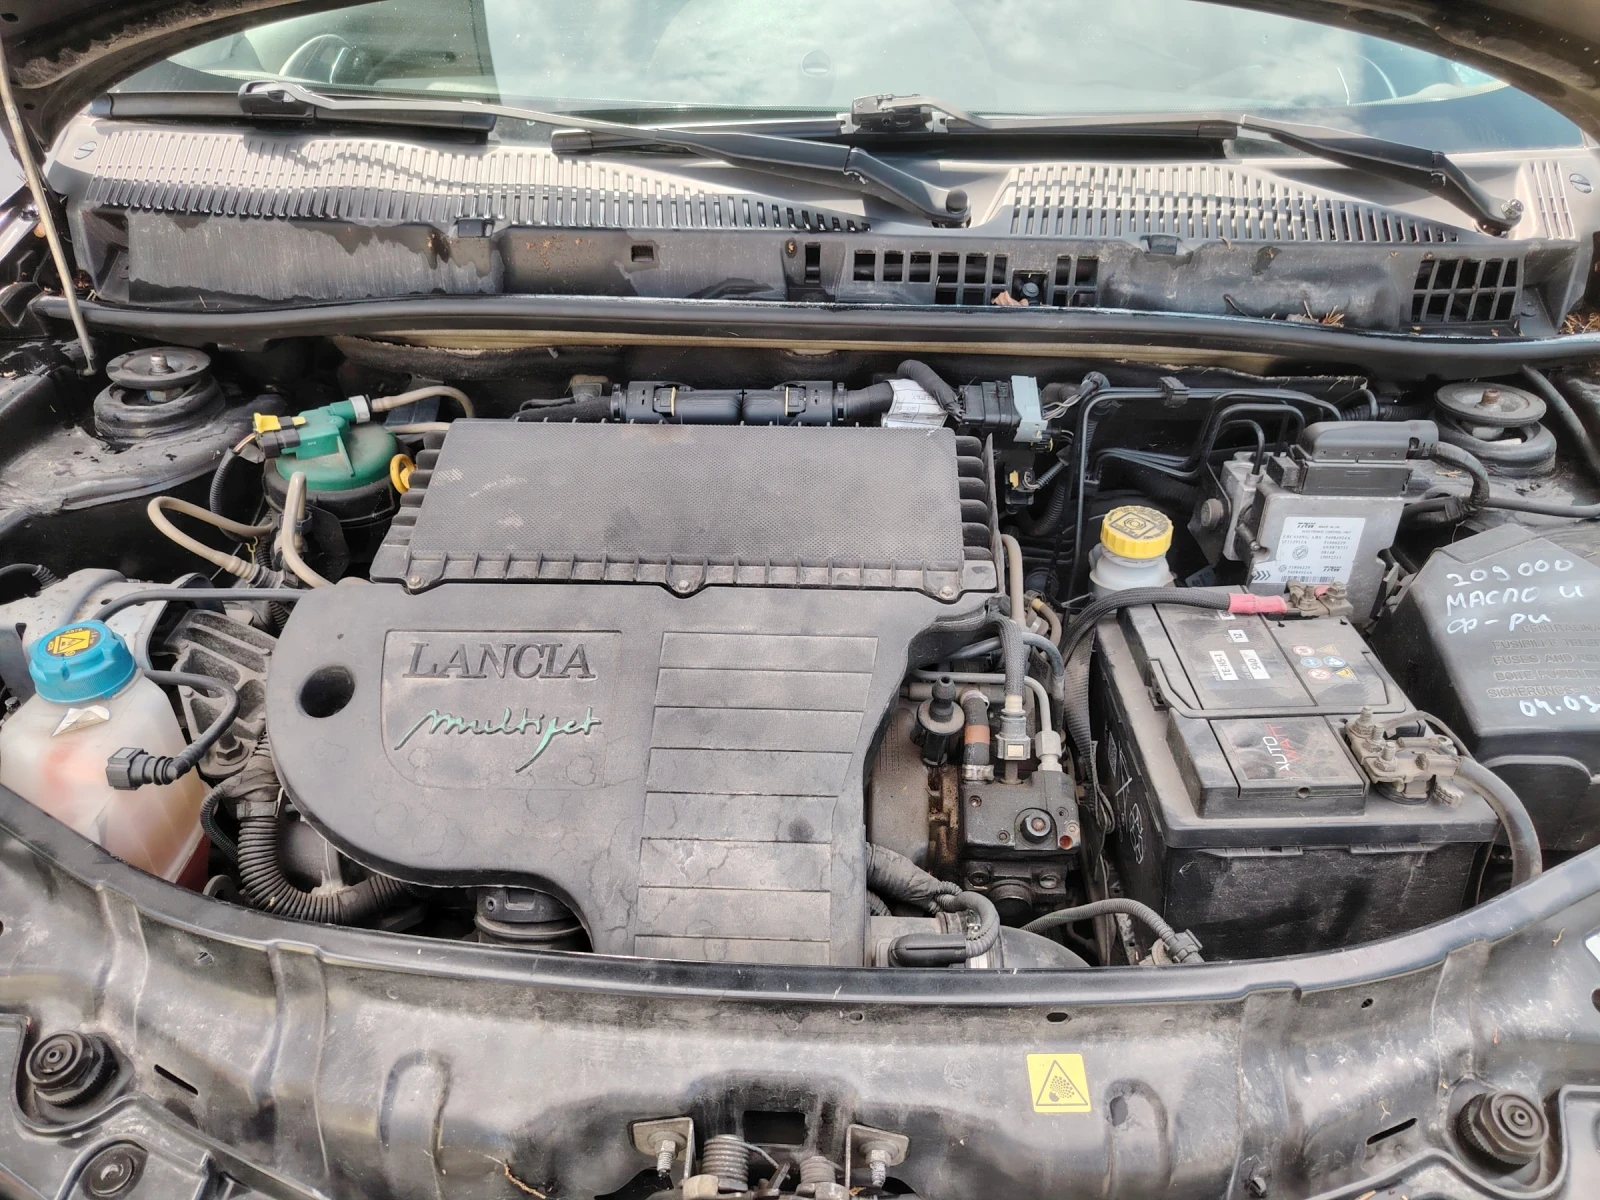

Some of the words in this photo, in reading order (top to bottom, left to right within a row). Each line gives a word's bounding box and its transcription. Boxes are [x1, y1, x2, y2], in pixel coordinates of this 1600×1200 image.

[1233, 632, 1244, 640] 12
[402, 642, 597, 679] LANCIA
[1492, 654, 1540, 665] FUSES
[1545, 652, 1574, 664] AND
[394, 706, 602, 773] multijet
